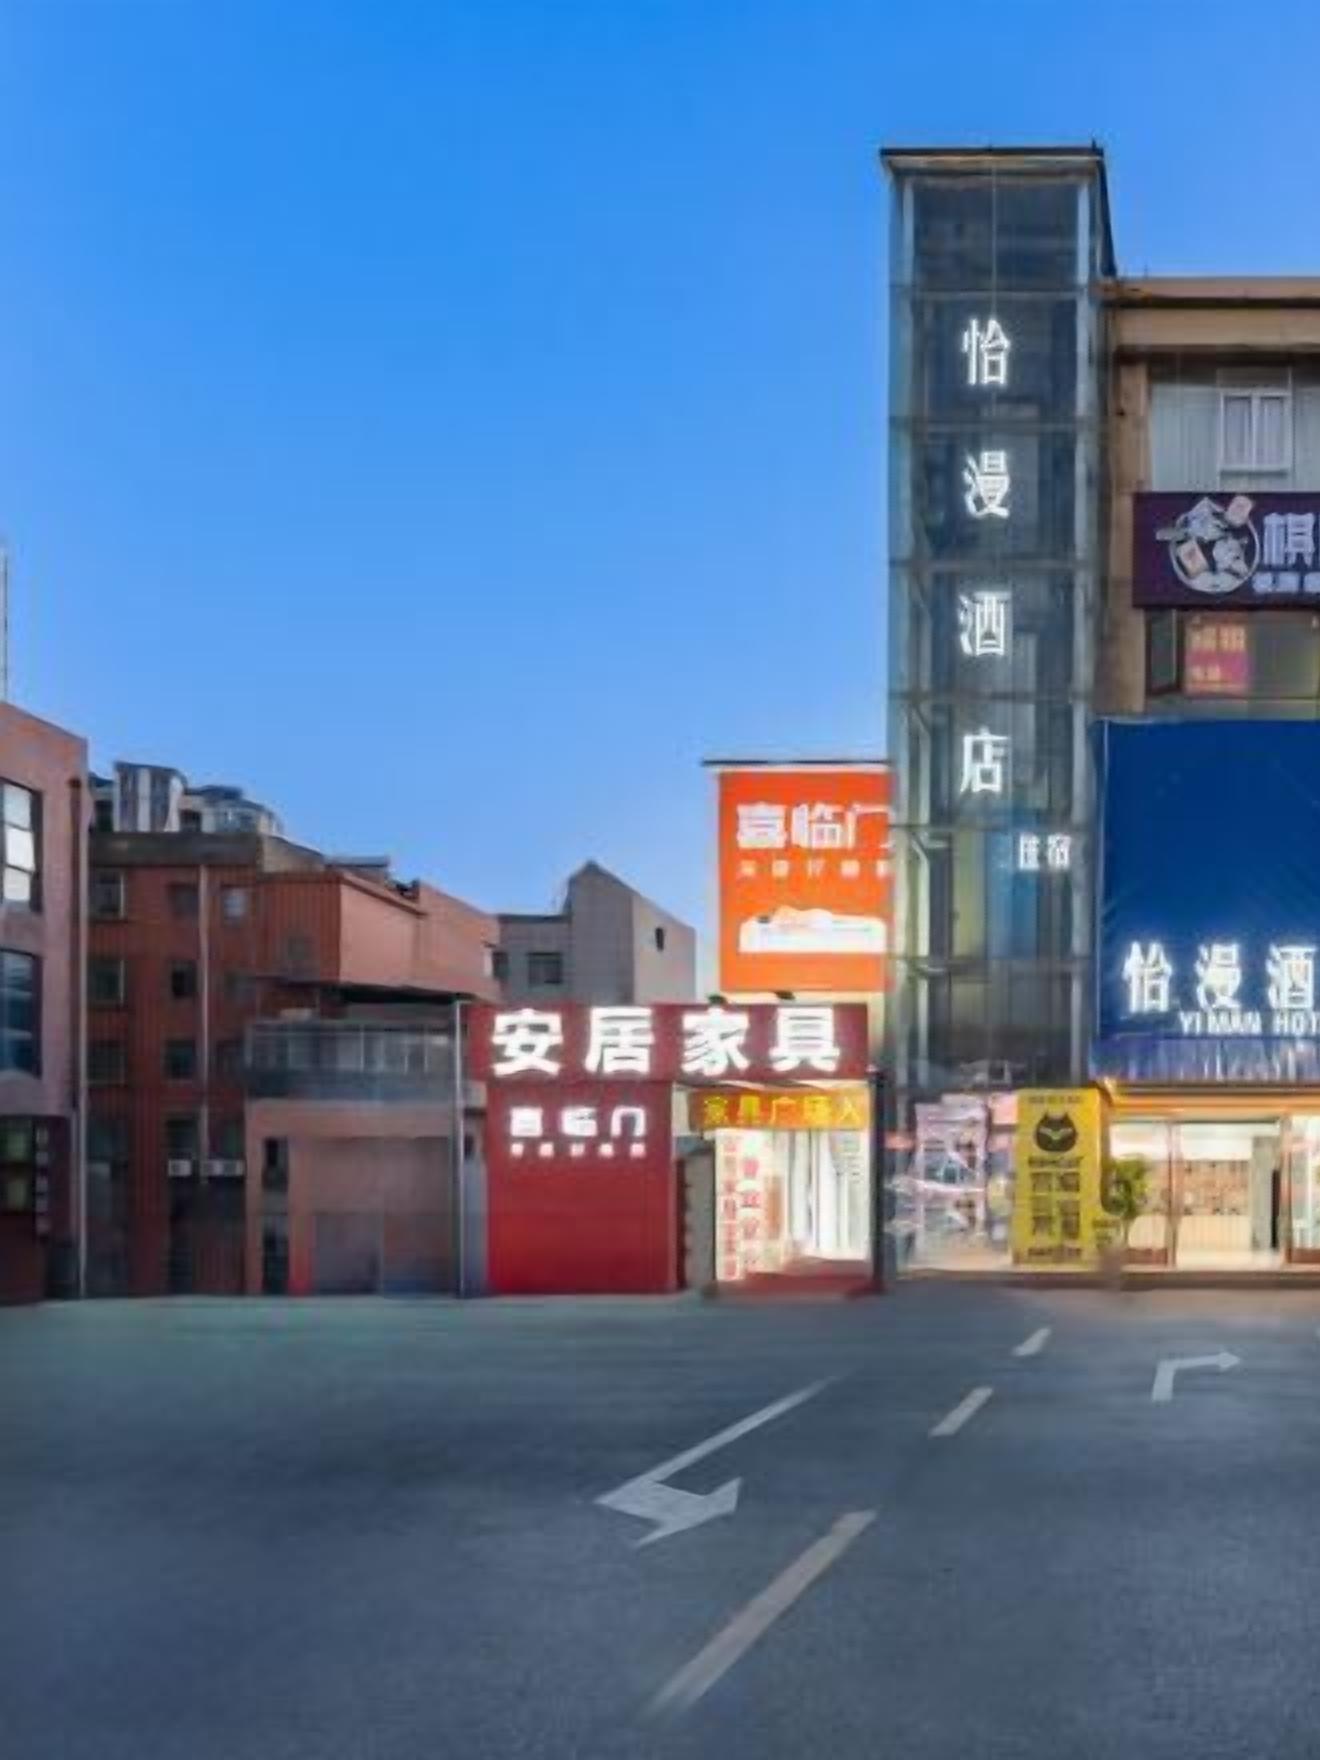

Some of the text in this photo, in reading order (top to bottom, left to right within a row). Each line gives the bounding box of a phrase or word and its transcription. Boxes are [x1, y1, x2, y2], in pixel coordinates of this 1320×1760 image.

[960, 317, 1011, 795] 怡漫酒店
[491, 1006, 841, 1077] 安居家具
